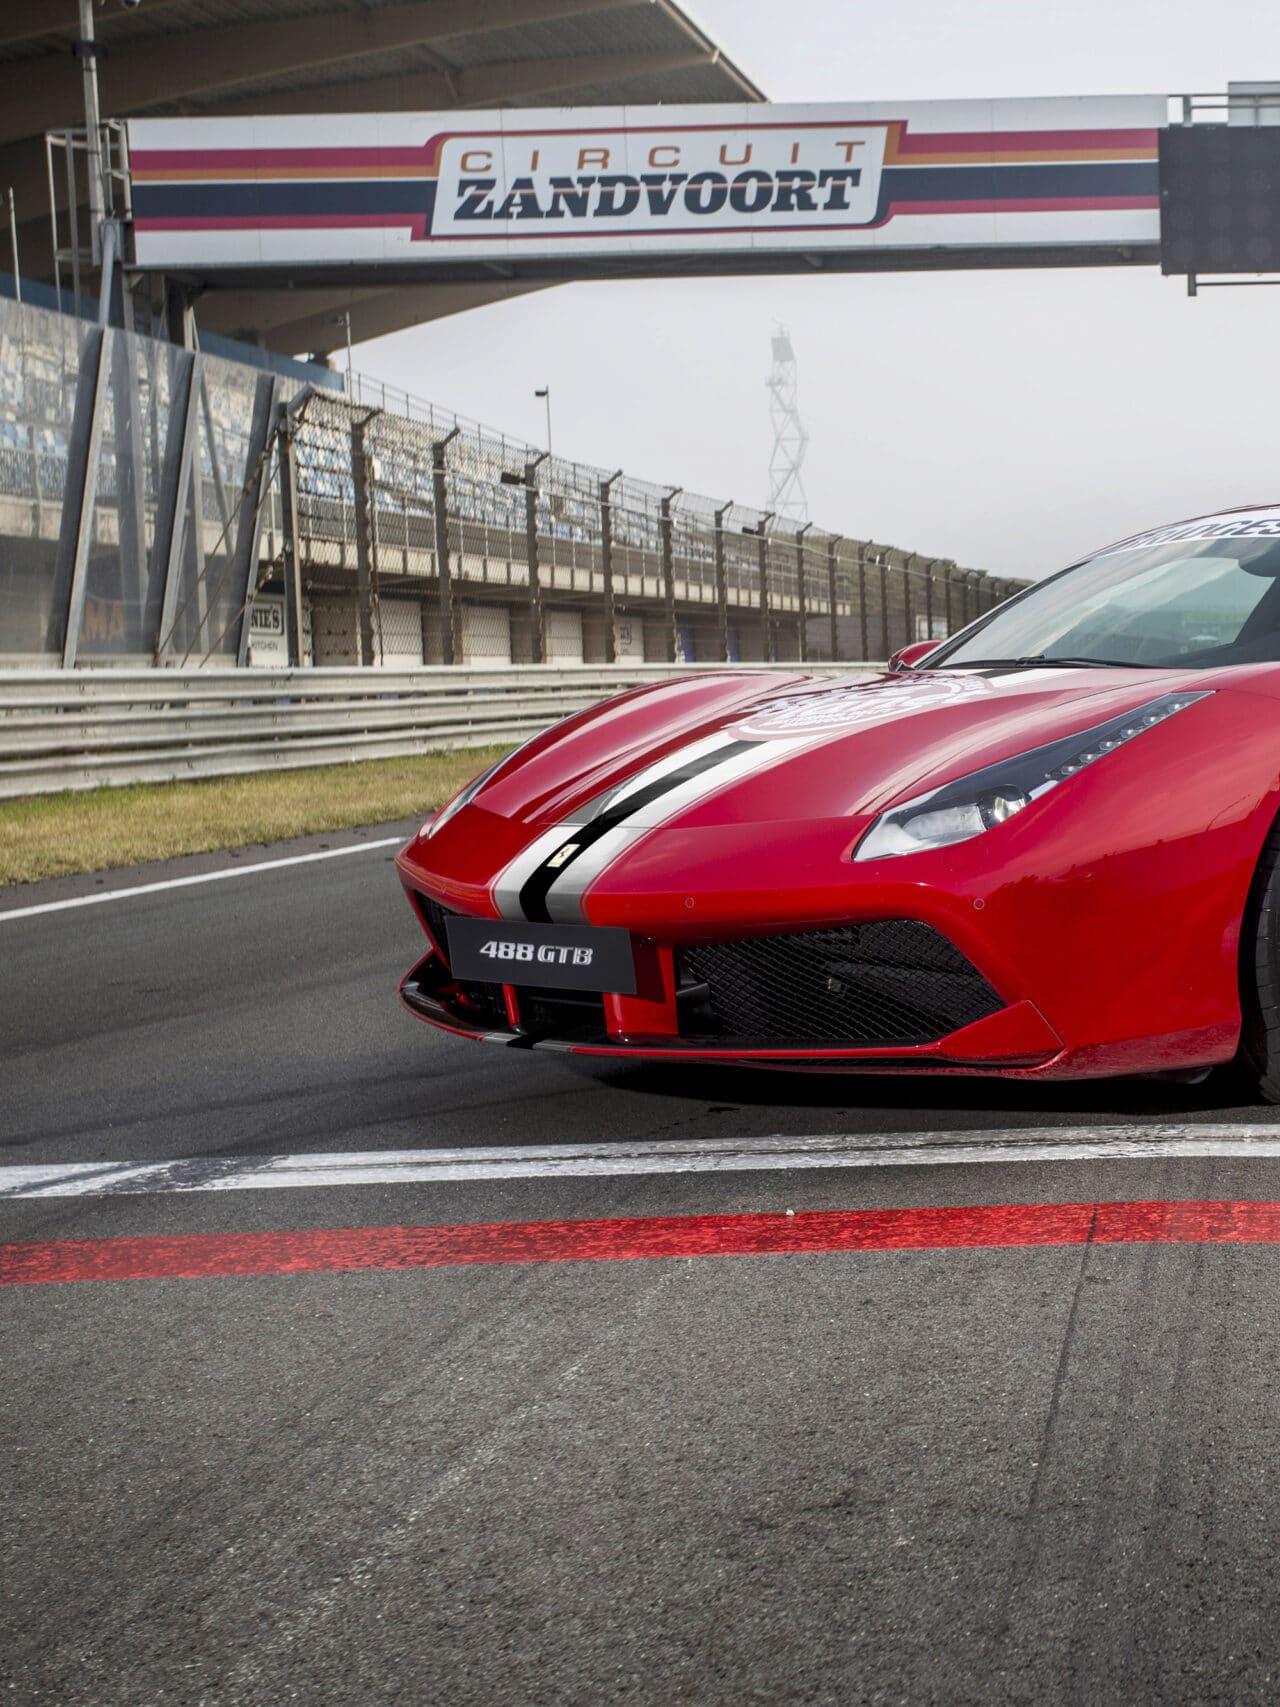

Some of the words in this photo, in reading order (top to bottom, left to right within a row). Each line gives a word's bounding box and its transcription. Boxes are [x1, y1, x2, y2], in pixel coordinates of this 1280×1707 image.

[460, 140, 866, 173] CIRCUIT
[453, 168, 862, 221] ZANDVOORT
[79, 599, 126, 641] MA
[251, 605, 280, 630] NIE'S
[479, 940, 535, 962] 488
[537, 945, 593, 966] GTB
